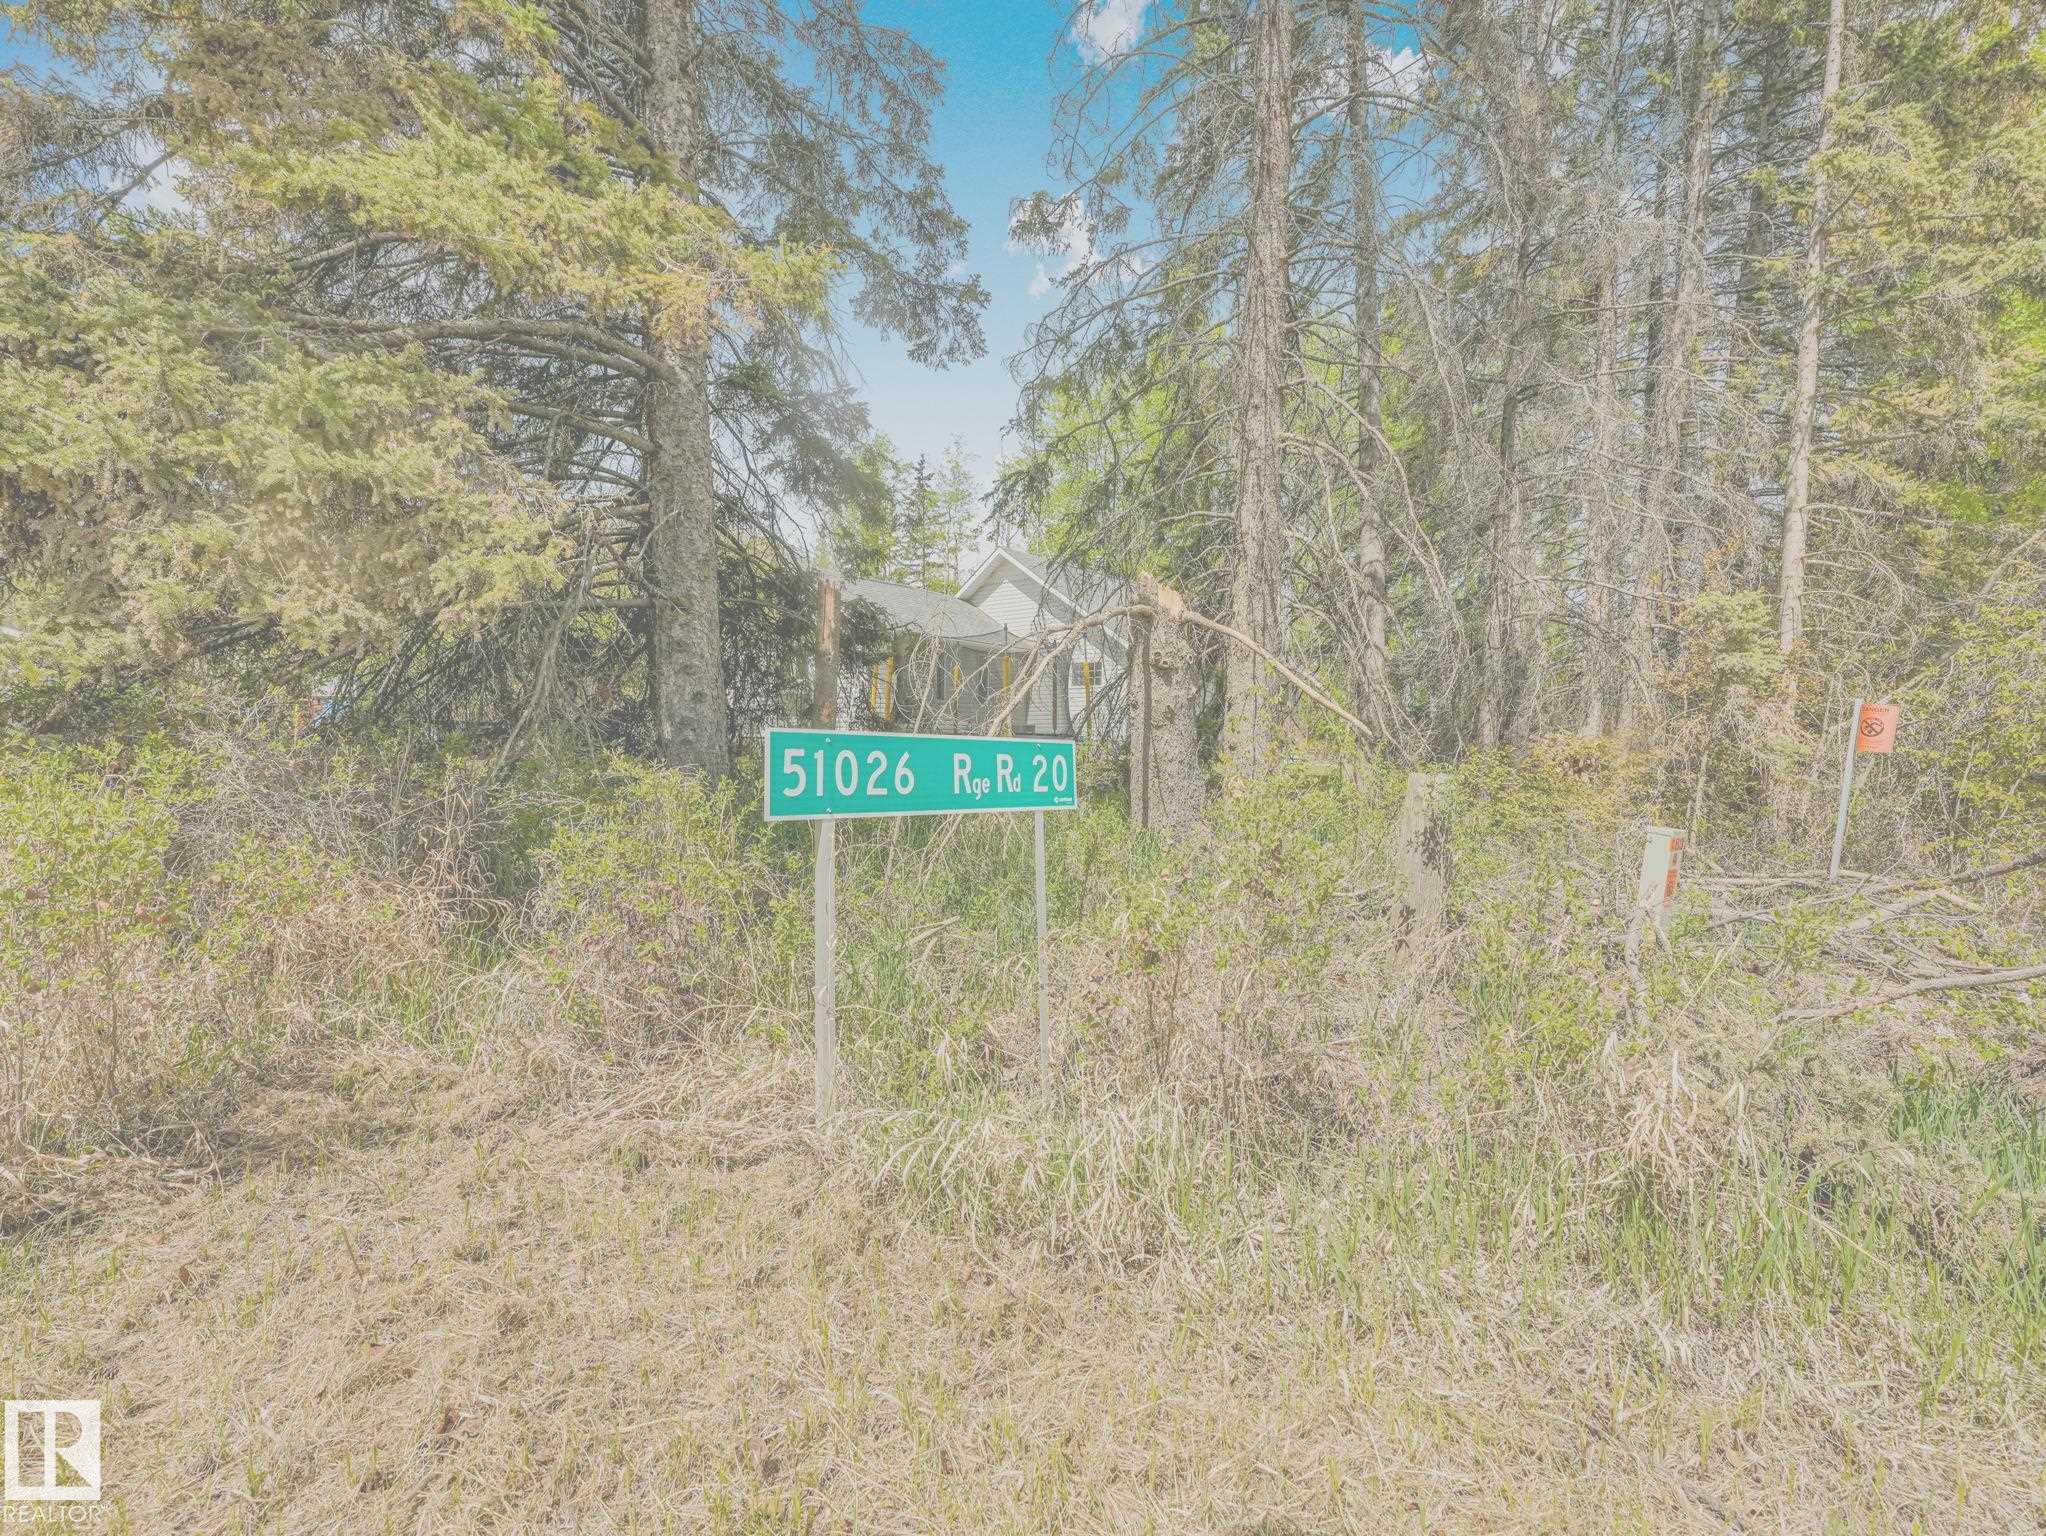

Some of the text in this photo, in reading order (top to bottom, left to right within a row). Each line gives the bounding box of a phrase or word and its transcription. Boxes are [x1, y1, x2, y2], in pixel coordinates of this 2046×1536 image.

[783, 748, 1068, 800] 51026 Rge Rd 20
